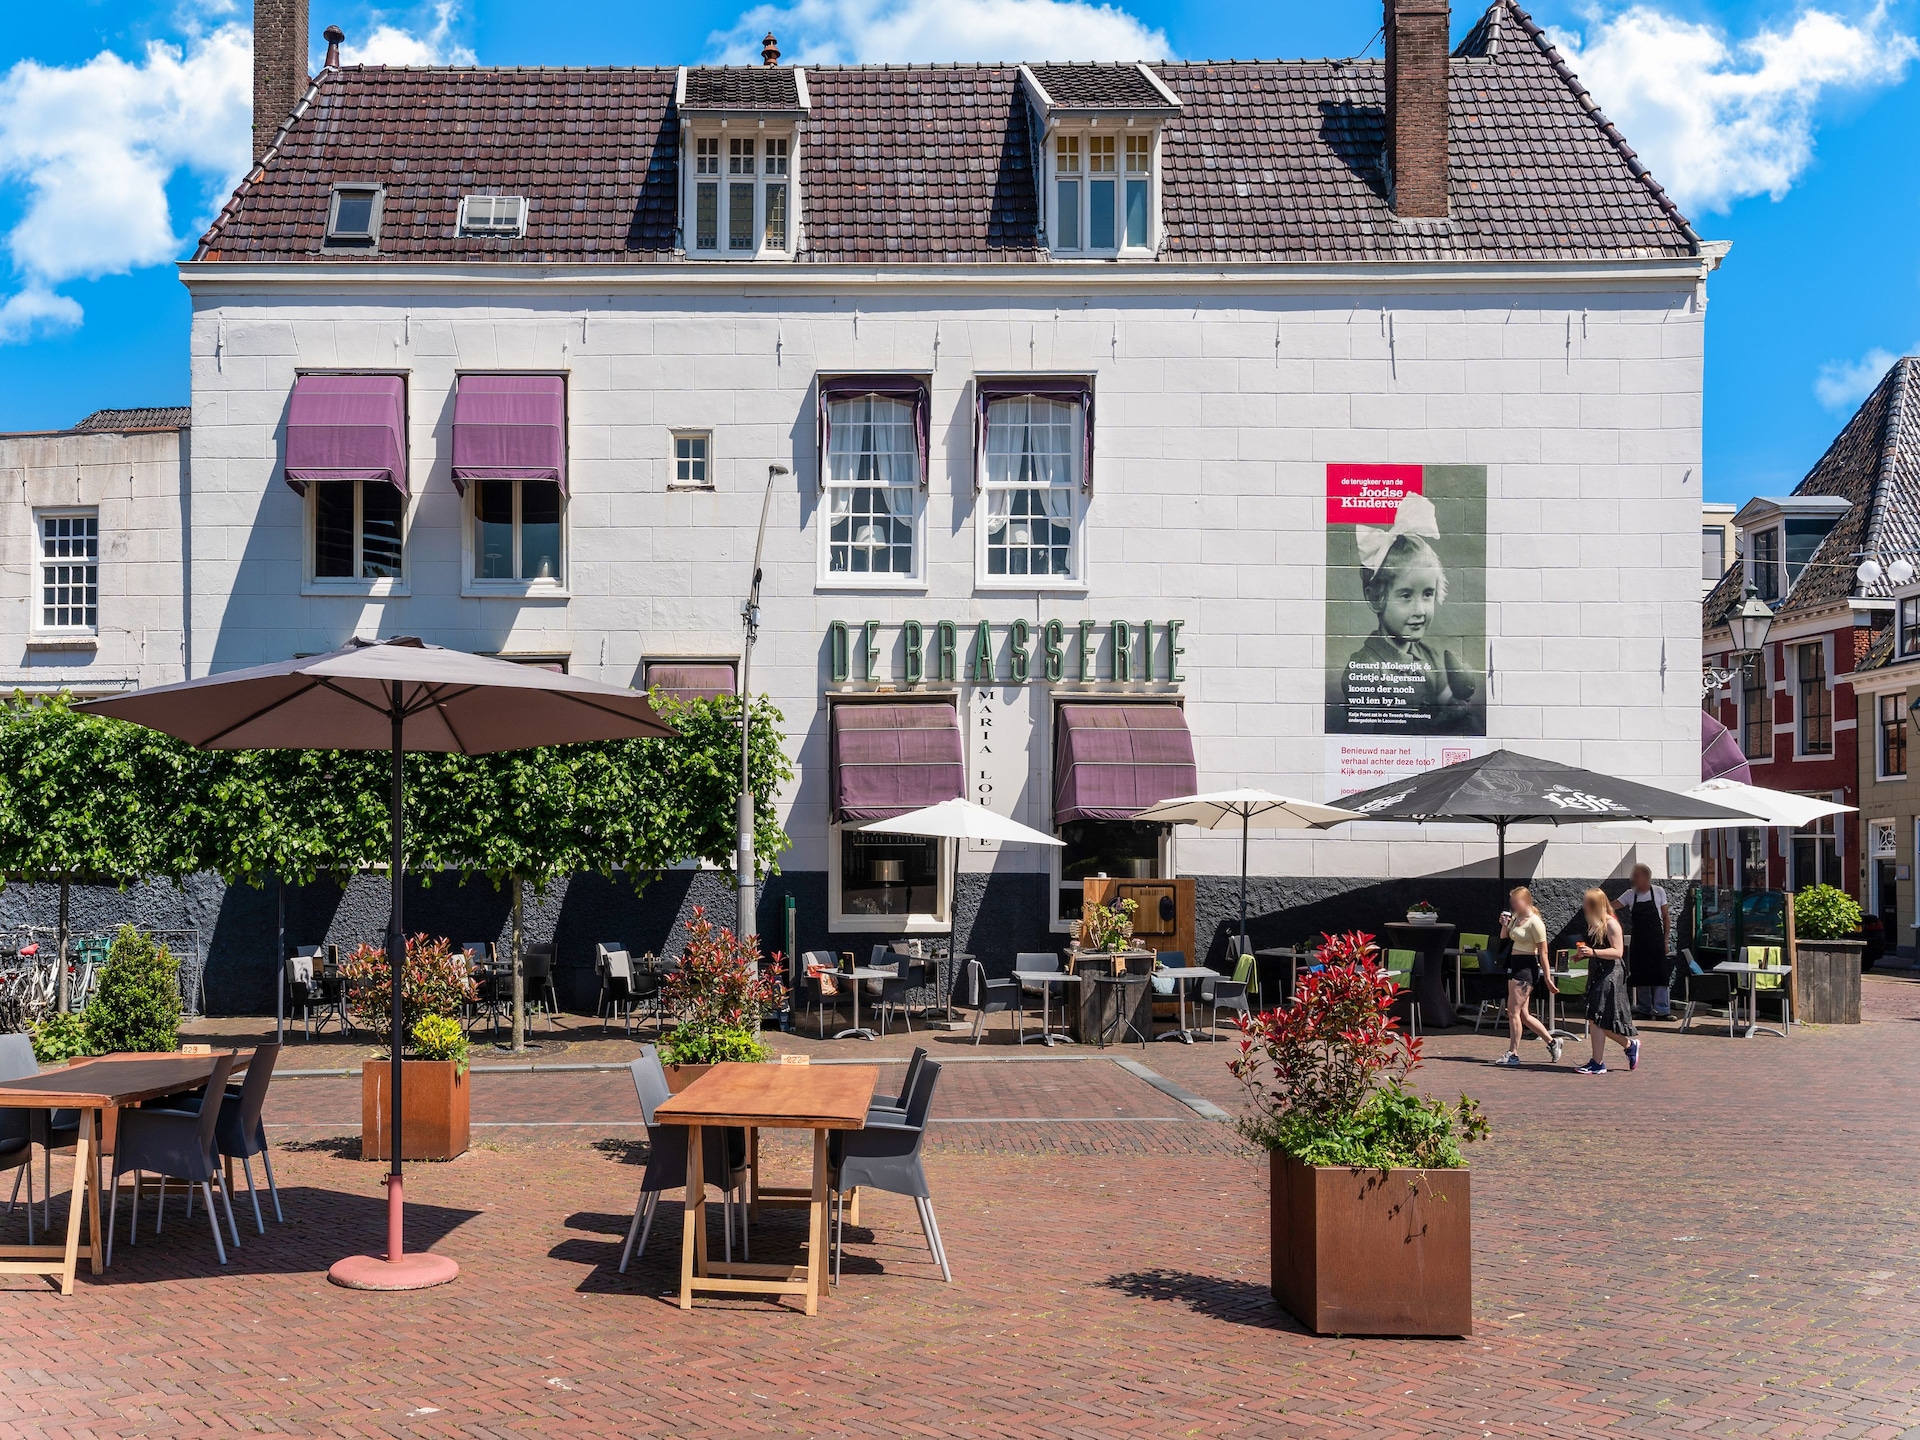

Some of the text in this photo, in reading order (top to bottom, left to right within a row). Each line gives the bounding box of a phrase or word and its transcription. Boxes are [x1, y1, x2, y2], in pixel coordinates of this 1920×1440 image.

[1350, 478, 1381, 486] terugkeer
[1360, 487, 1403, 497] Joodse
[831, 617, 1186, 684] DE BRASSERIE
[1348, 661, 1380, 669] Gerard
[1381, 661, 1422, 672] Molewijk
[1348, 673, 1426, 683] Grietje Jelgersma
[1377, 685, 1392, 693] der
[1382, 697, 1393, 706] by
[1395, 697, 1406, 705] ha
[1341, 746, 1378, 755] Benieuwd
[1399, 747, 1411, 755] het
[1341, 757, 1369, 765] verhaal
[1396, 758, 1414, 766] deze
[1415, 758, 1436, 766] foto?
[978, 691, 995, 846] MARIA LOUE
[1341, 767, 1355, 777] Kijk
[1373, 769, 1386, 777] op:
[1541, 792, 1618, 812] Leffe
